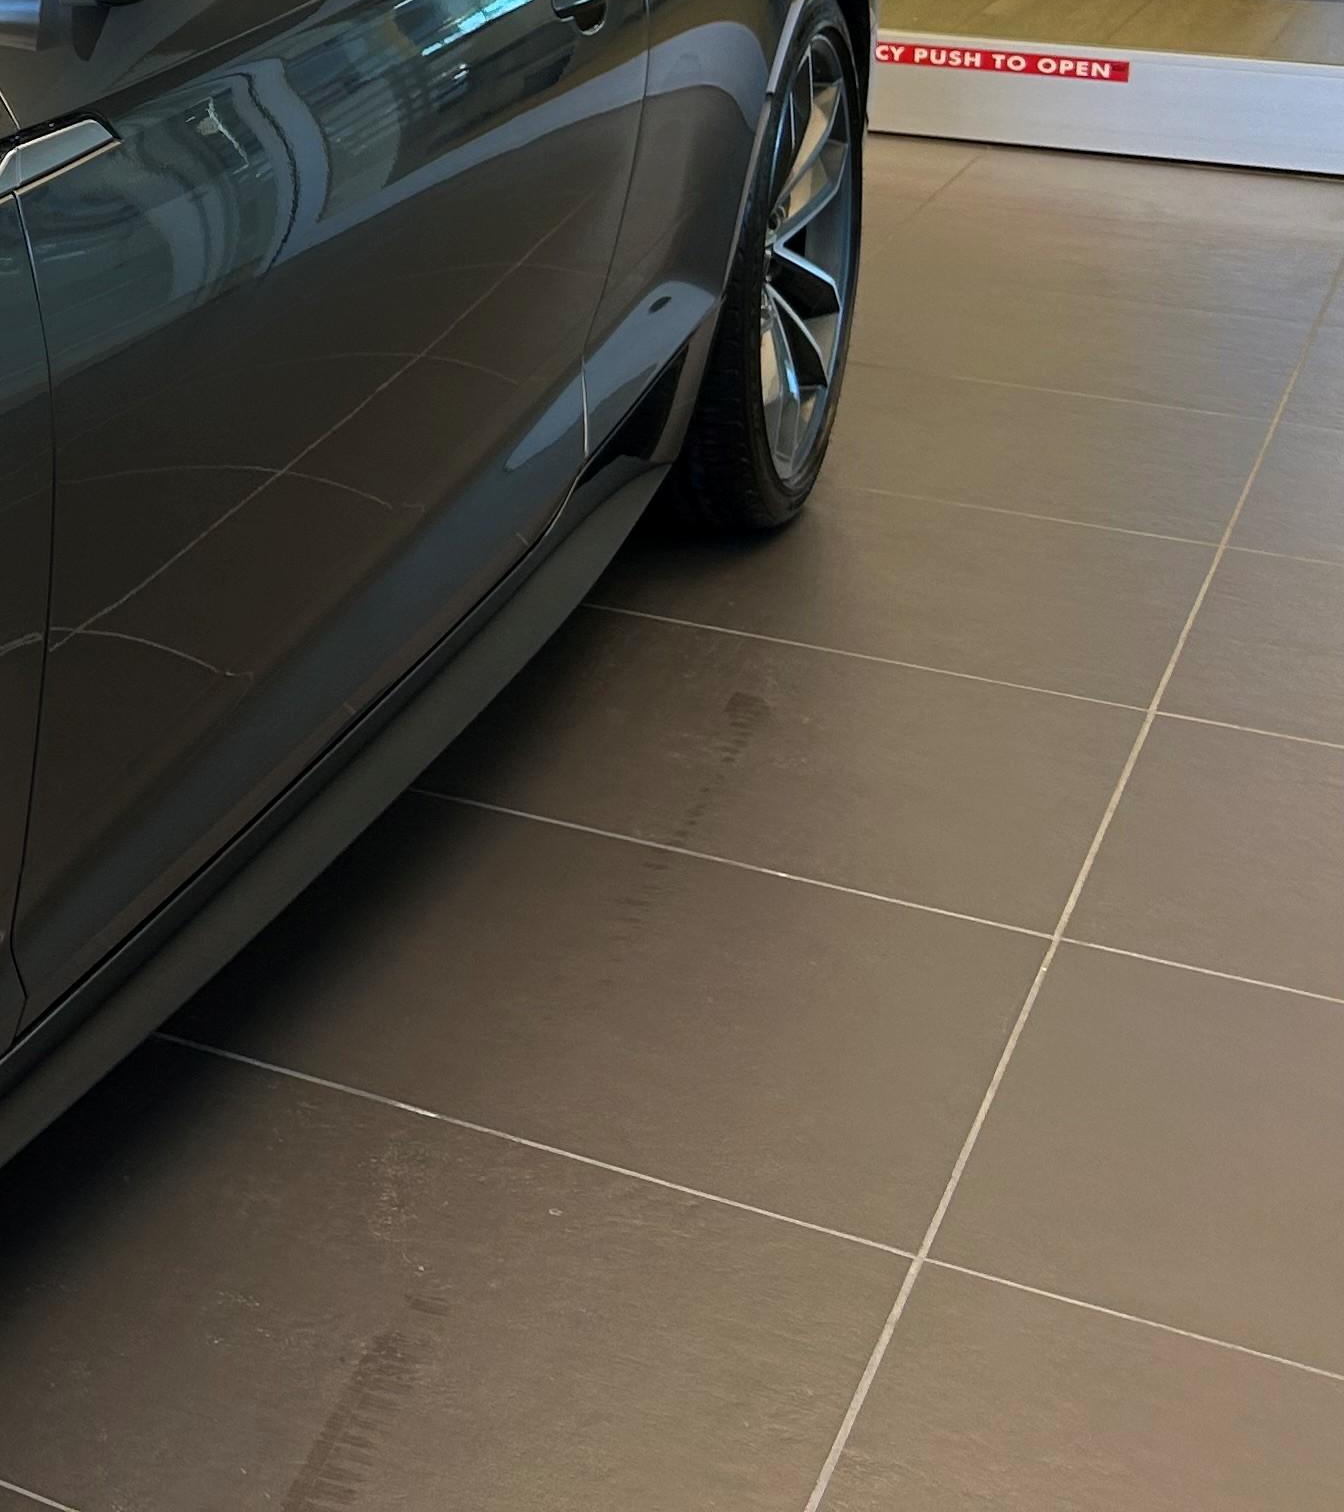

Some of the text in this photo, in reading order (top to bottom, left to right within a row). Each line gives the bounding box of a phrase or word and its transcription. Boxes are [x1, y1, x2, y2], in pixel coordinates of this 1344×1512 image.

[914, 46, 981, 68] PUSH
[992, 53, 1026, 71] TO
[1037, 57, 1111, 80] OPEN
